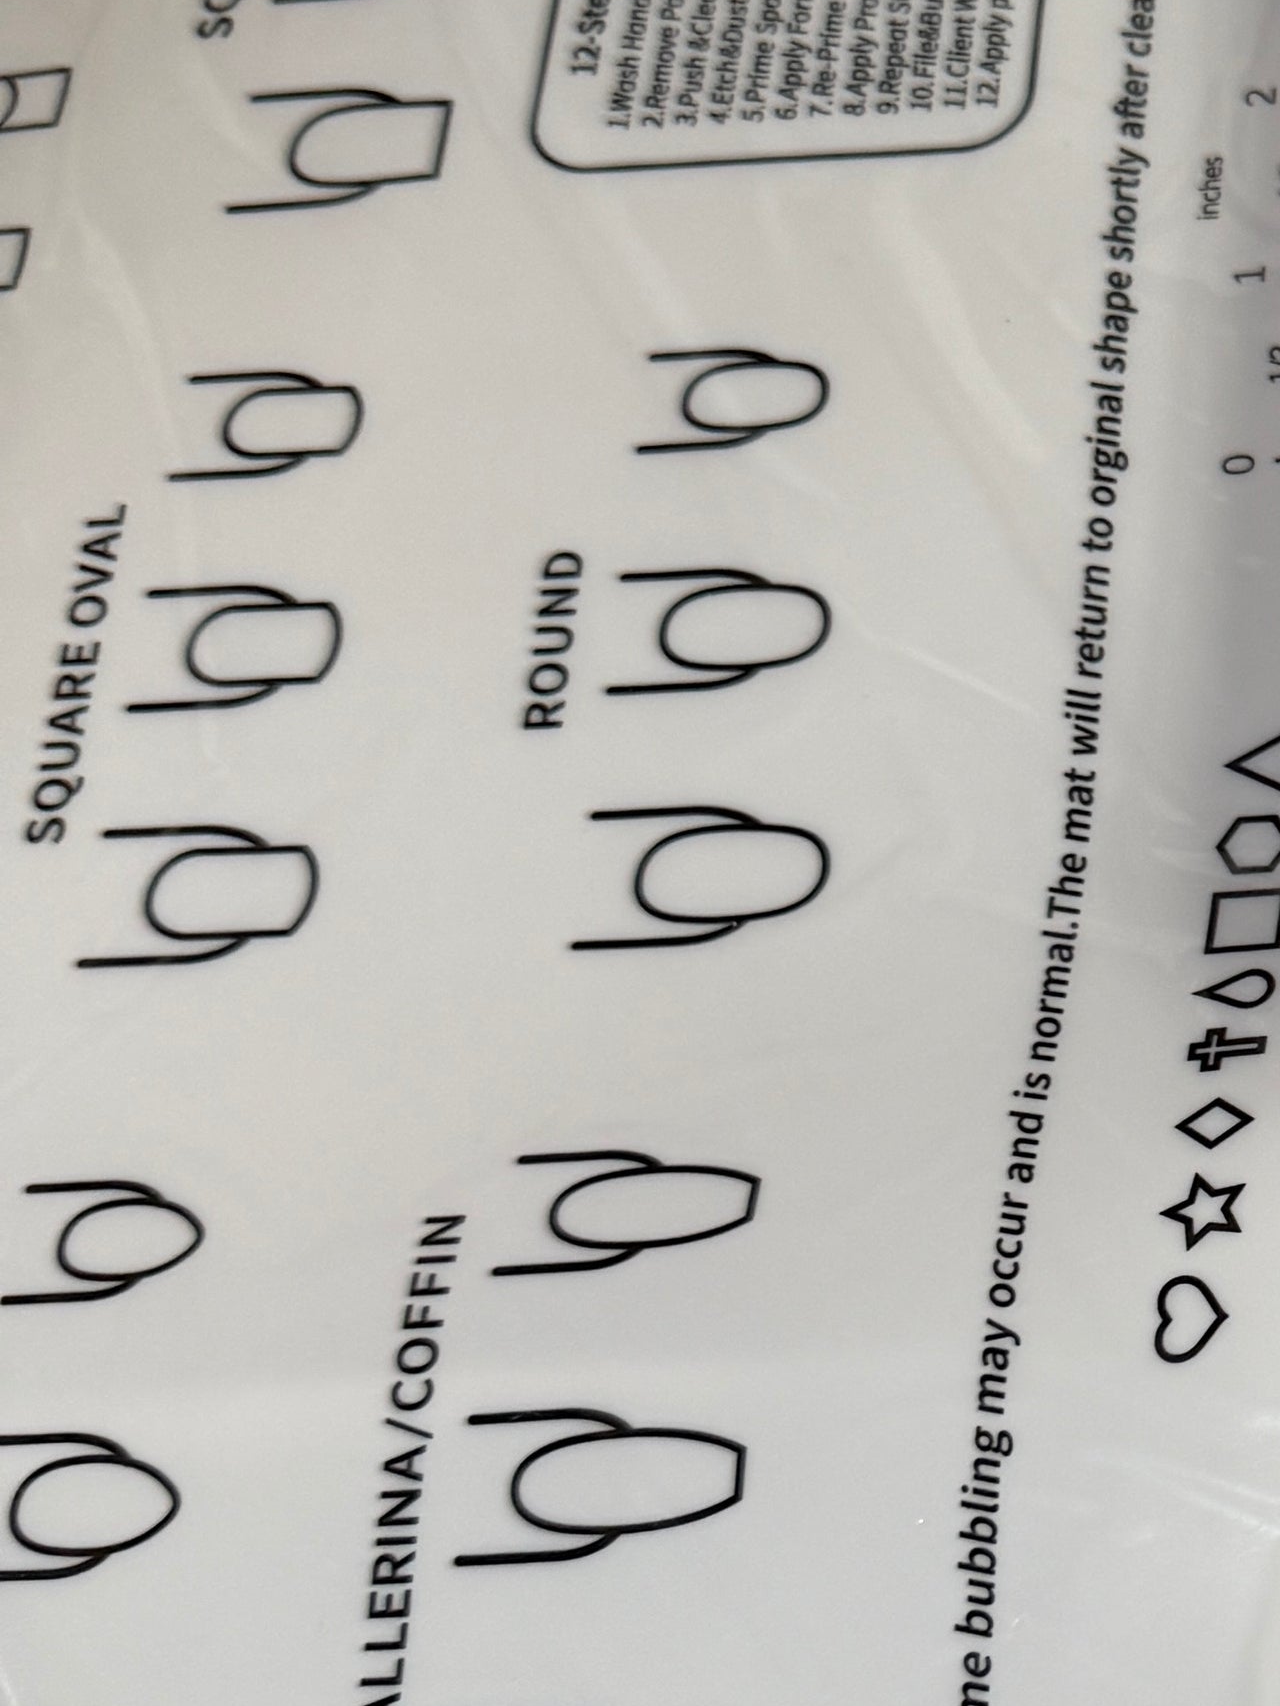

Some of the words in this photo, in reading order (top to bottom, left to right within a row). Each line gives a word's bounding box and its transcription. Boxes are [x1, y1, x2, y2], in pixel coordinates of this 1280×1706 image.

[641, 26, 676, 127] 2.Remove
[741, 41, 775, 121] 5.Prime
[774, 40, 813, 120] 6.Apply
[842, 35, 879, 116] 8.Apply
[876, 19, 911, 114] 9.Repeat
[943, 16, 976, 108] 11.Client
[1112, 63, 1149, 140] after
[1244, 87, 1278, 107] 2
[1101, 146, 1150, 263] shortly
[1197, 156, 1224, 220] inches
[1233, 265, 1267, 284] 1
[1092, 270, 1139, 374] shape
[1085, 381, 1129, 507] orginal
[1221, 454, 1256, 476] 0
[1081, 516, 1114, 552] to
[522, 551, 583, 731] ROUND
[1074, 564, 1110, 679] return
[24, 641, 102, 844] SQUARE
[67, 504, 127, 628] OVAL
[1064, 688, 1102, 756] will
[1066, 767, 1096, 843] mat
[1015, 1072, 1052, 1101] is
[1007, 1110, 1045, 1184] and
[988, 1191, 1029, 1308] occur
[977, 1317, 1021, 1415] may
[953, 1425, 1014, 1638] bubbling
